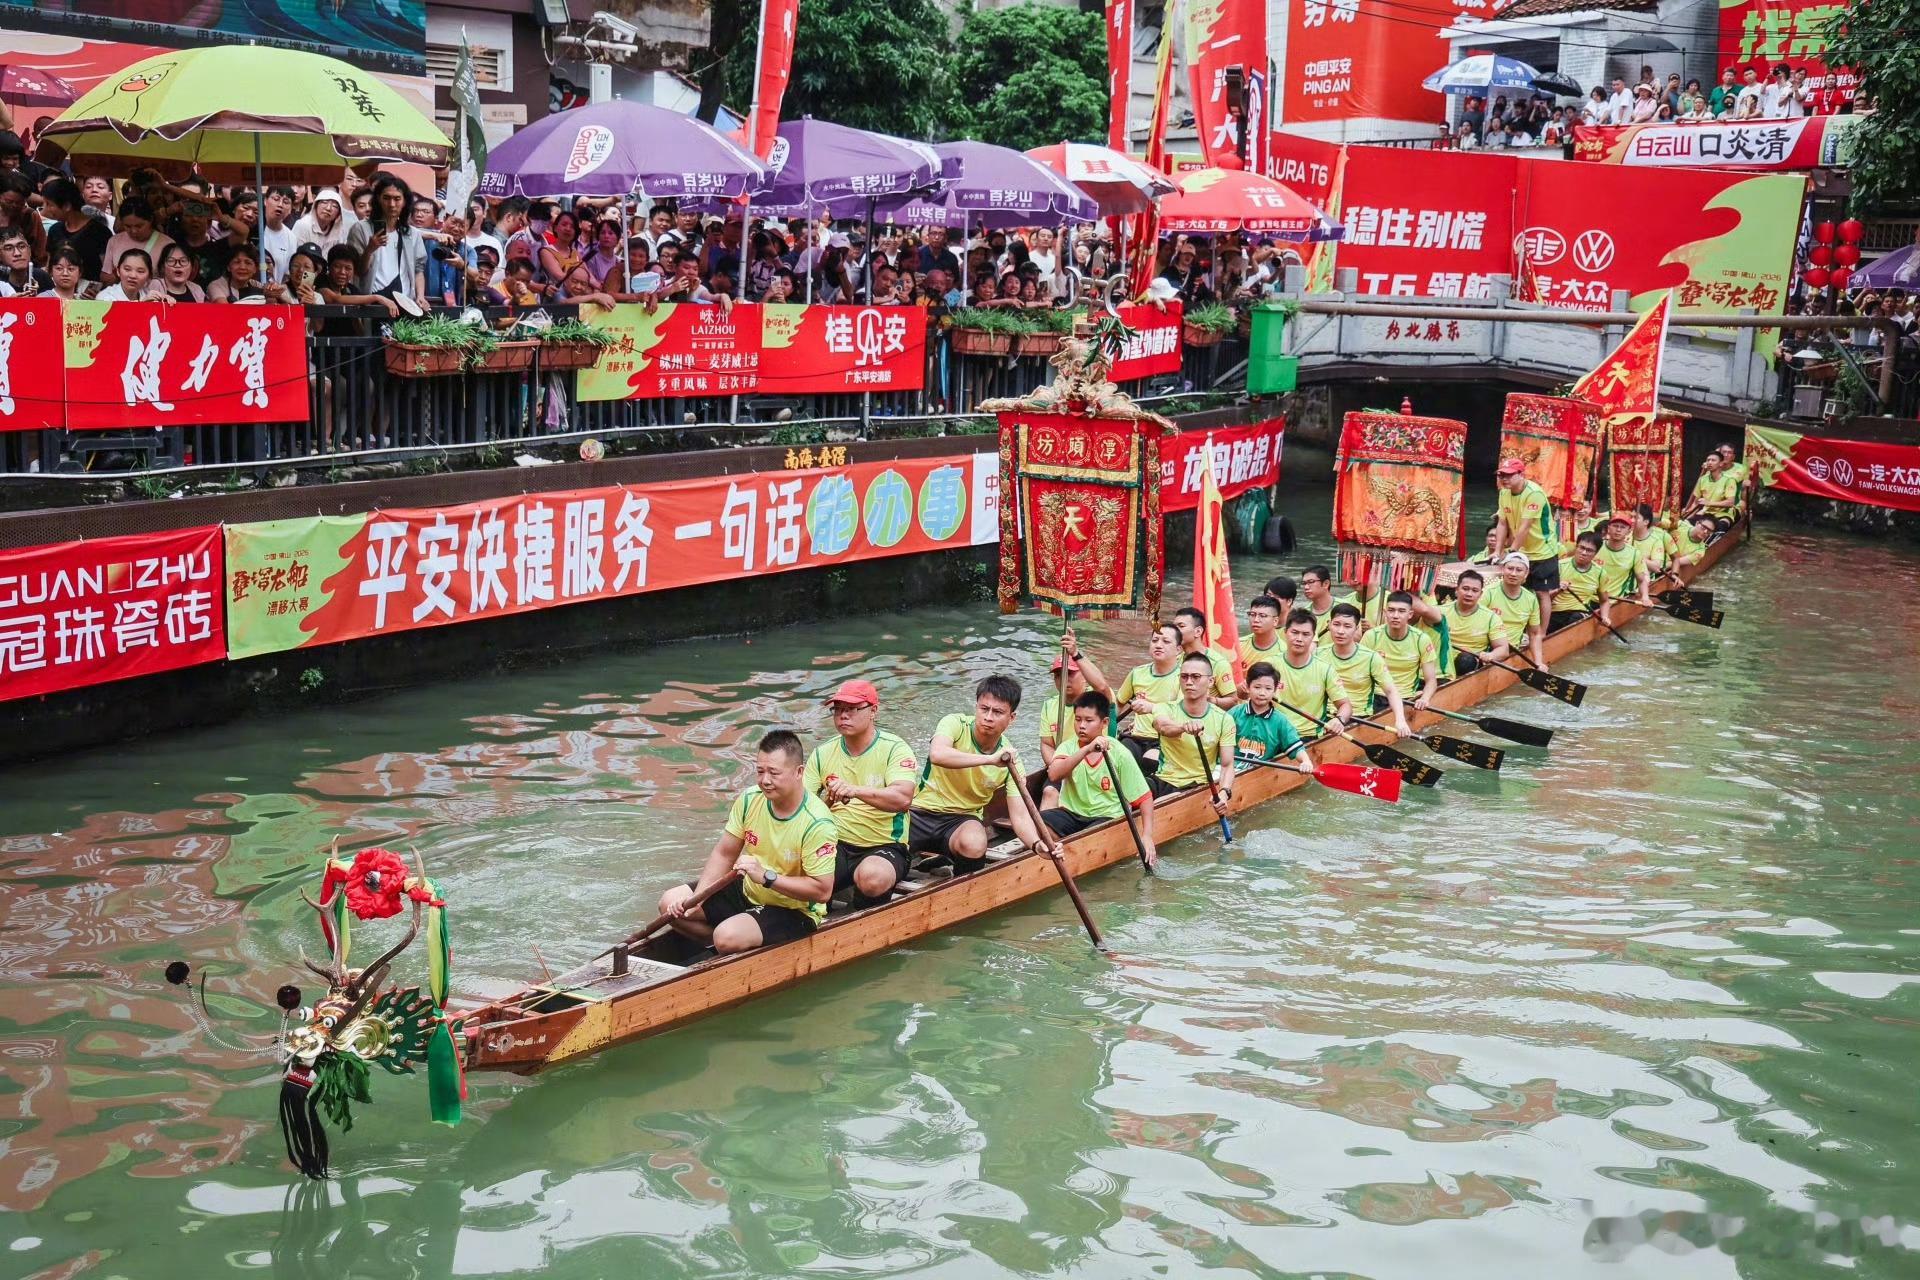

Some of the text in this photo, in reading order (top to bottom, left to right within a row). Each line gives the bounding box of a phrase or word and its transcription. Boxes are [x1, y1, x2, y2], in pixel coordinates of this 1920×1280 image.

[1304, 58, 1352, 77] 中国平安
[1636, 136, 1692, 157] 白云山
[1699, 127, 1792, 161] 口炎清
[480, 172, 507, 187] 百岁山
[682, 173, 727, 187] 百岁山
[850, 173, 896, 189] 百岁山
[1310, 163, 1328, 187] T6
[989, 189, 1033, 202] 百岁山
[1344, 206, 1488, 250] 稳住别慌
[691, 325, 736, 335] LAIZHOU
[657, 376, 708, 392] 多重风味
[844, 370, 893, 384] 广东平安消防
[1857, 463, 1920, 486] 一汽-大众
[1063, 505, 1088, 542] 天
[359, 464, 964, 629] 平安快捷服务 一句话能办事
[266, 596, 309, 616] 漂移大赛
[0, 590, 211, 673] 冠珠瓷砖
